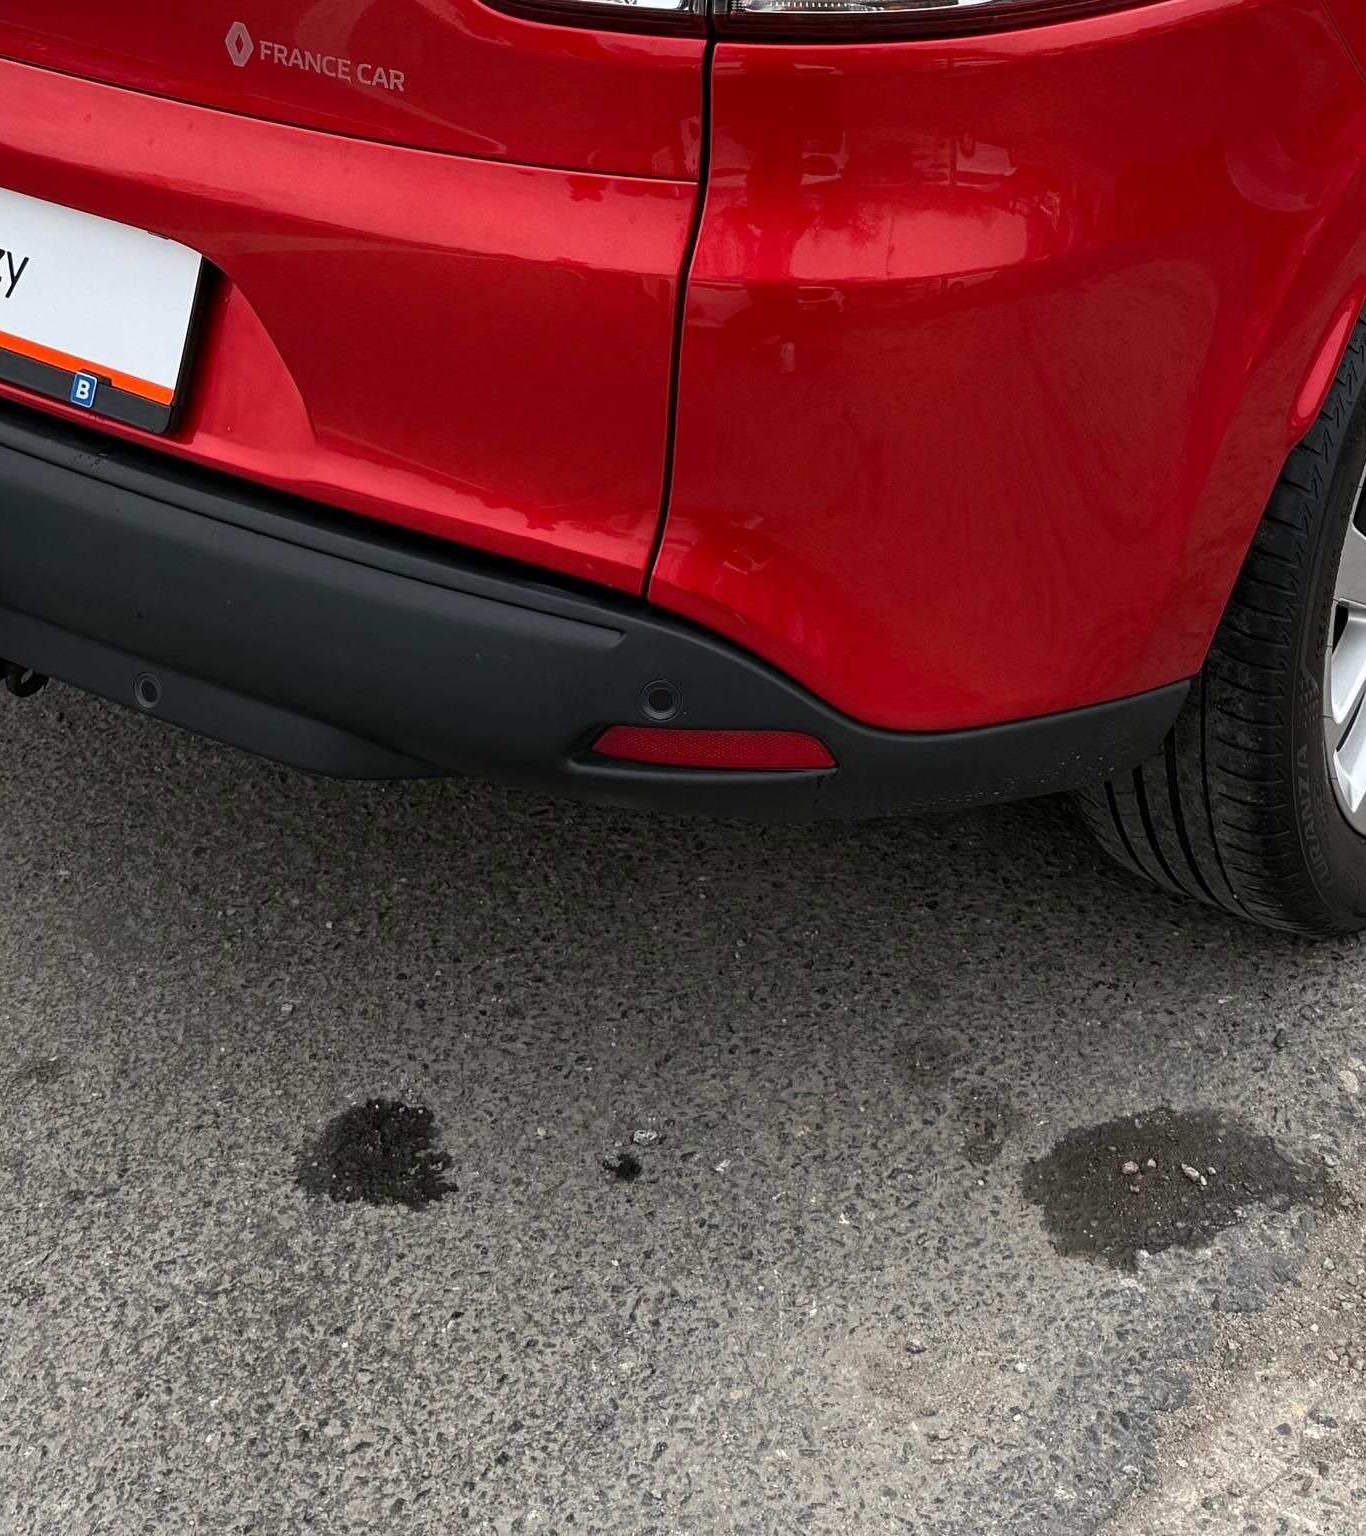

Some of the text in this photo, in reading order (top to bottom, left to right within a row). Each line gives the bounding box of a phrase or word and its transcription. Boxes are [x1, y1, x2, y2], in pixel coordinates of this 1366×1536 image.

[259, 39, 405, 92] FRANCE CAR
[75, 379, 90, 401] B
[1296, 743, 1333, 889] TURANZA
